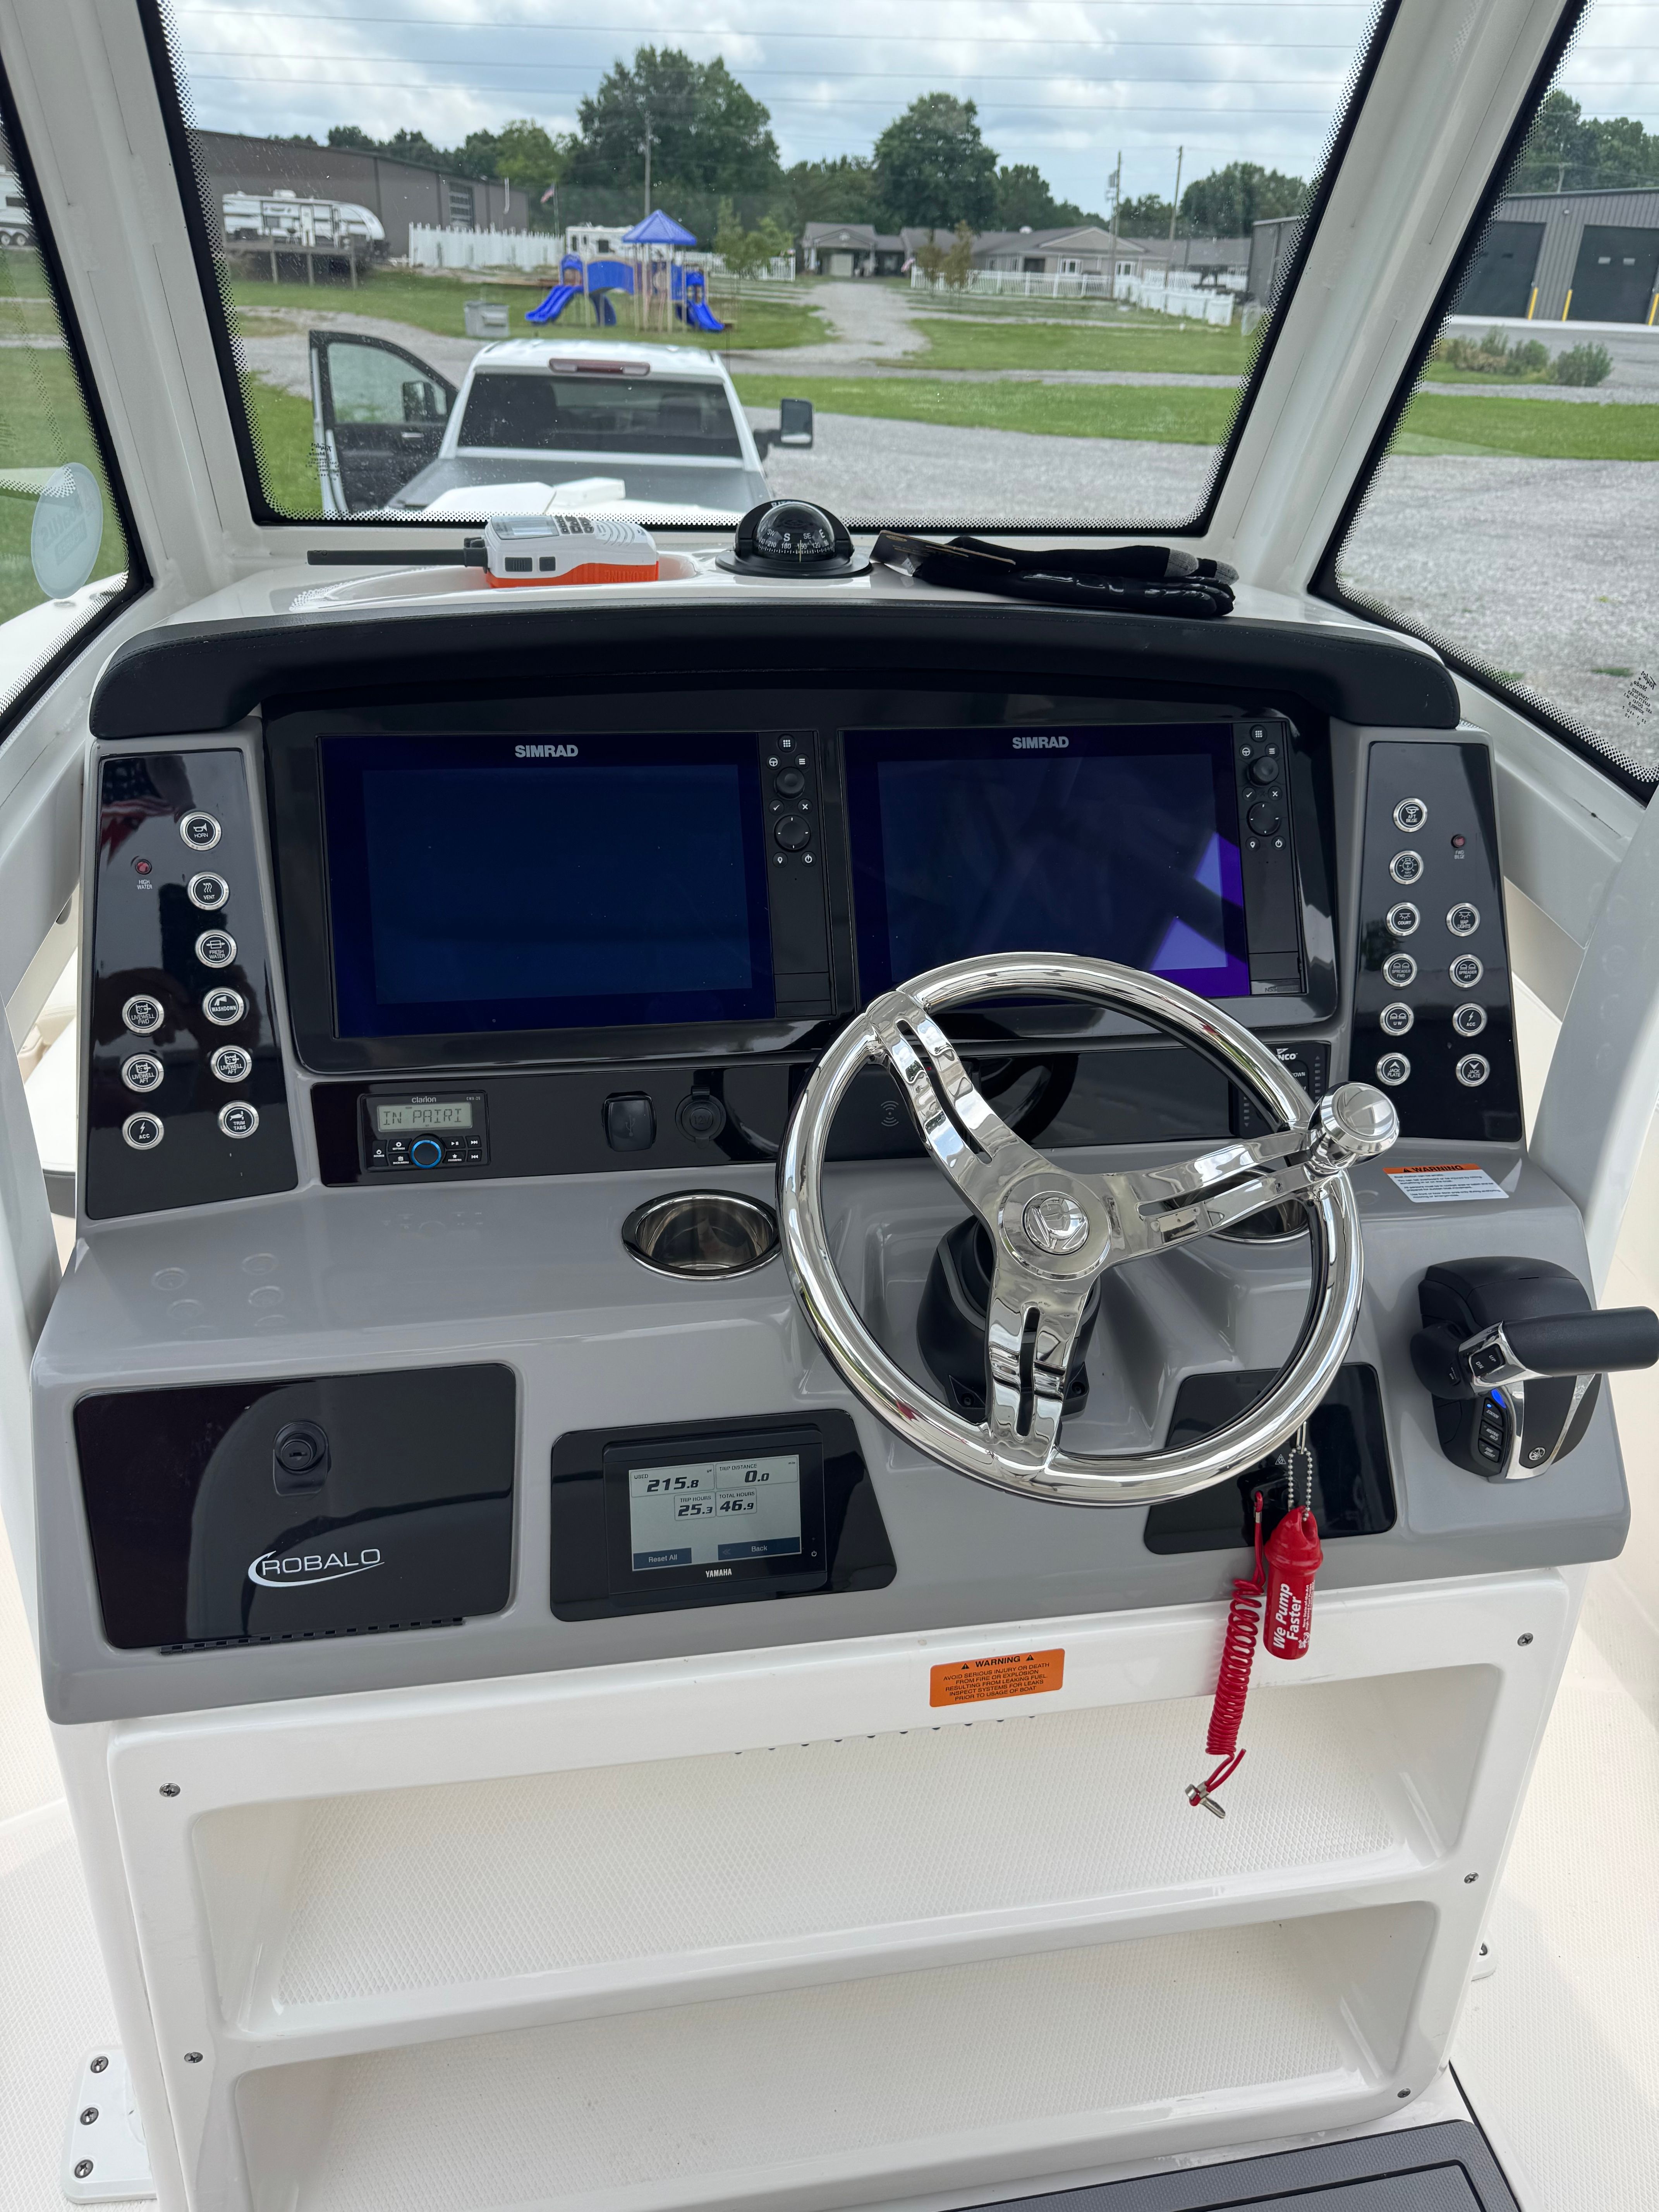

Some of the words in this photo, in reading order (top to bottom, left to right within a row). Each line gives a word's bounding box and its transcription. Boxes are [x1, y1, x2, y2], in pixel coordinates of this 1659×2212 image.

[783, 533, 790, 542] S
[819, 529, 825, 539] E
[1012, 736, 1069, 749] SIMRAD
[515, 745, 578, 758] SIMRAD
[383, 1111, 402, 1125] IN
[412, 1108, 462, 1123] PAIRI
[744, 1470, 769, 1483] 0.0
[647, 1477, 699, 1492] 215.8
[678, 1503, 713, 1516] 25.3
[720, 1499, 754, 1512] 46.9
[261, 1548, 381, 1576] ROBALO
[706, 1568, 732, 1578] YAMAHA
[1275, 1583, 1293, 1625] Pump
[1286, 1596, 1302, 1640] Faster
[1273, 1626, 1286, 1649] We
[975, 1656, 1020, 1668] WARNING
[964, 1670, 992, 1678] SERIOUS
[1003, 1670, 1039, 1678] EXPLOSION
[946, 1683, 980, 1692] RESULTING
[978, 1684, 1007, 1692] SYSTEMS
